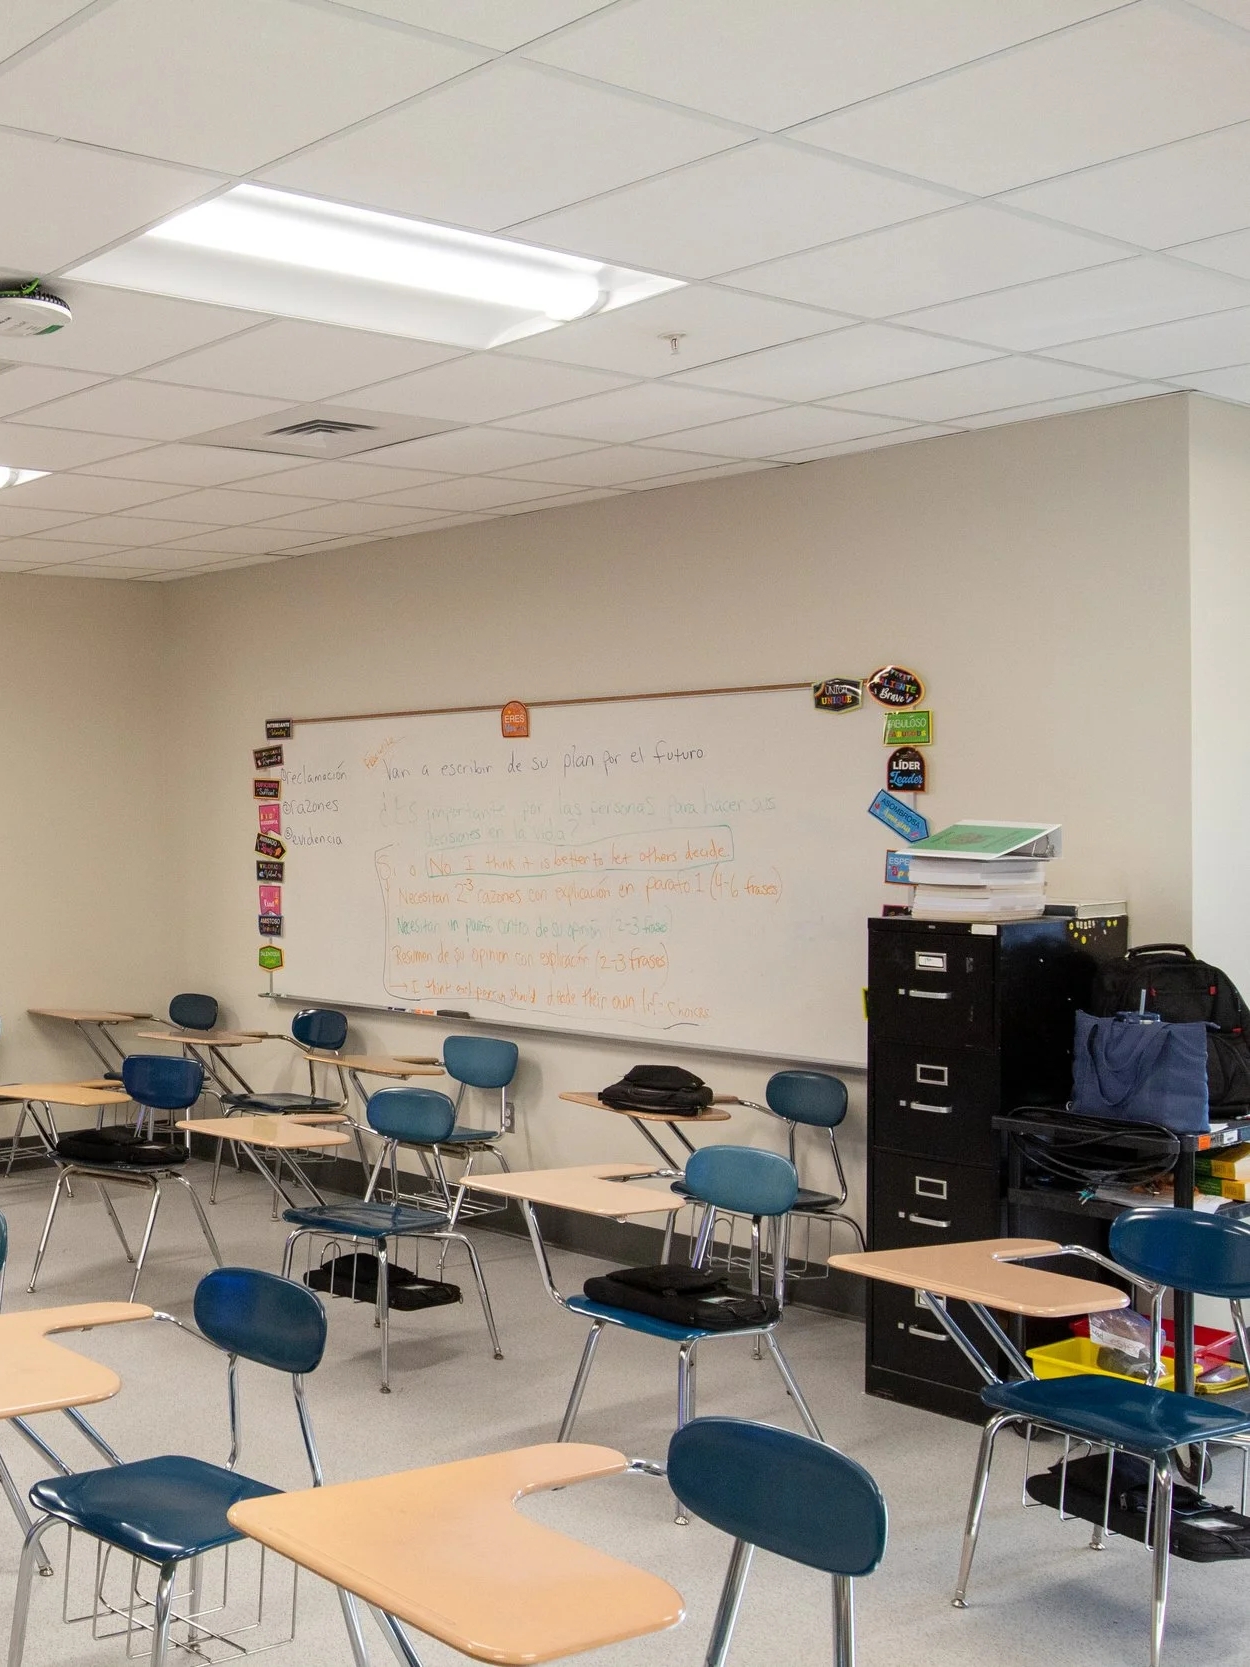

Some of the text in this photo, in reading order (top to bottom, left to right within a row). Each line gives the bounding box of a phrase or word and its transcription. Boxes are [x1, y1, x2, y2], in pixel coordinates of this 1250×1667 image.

[821, 695, 852, 705] UNIQUE
[879, 687, 905, 703] Brave
[505, 714, 524, 723] ERES
[441, 761, 492, 776] escribir
[508, 750, 522, 773] de
[532, 756, 549, 771] su
[563, 745, 594, 777] plan
[603, 750, 620, 776] por
[630, 747, 644, 763] el
[653, 740, 704, 764] futuro
[892, 759, 920, 770] LÍDER
[890, 771, 923, 787] Leader
[881, 798, 920, 829] ASOMBROSA
[640, 844, 678, 863] others
[889, 857, 910, 865] ESPE
